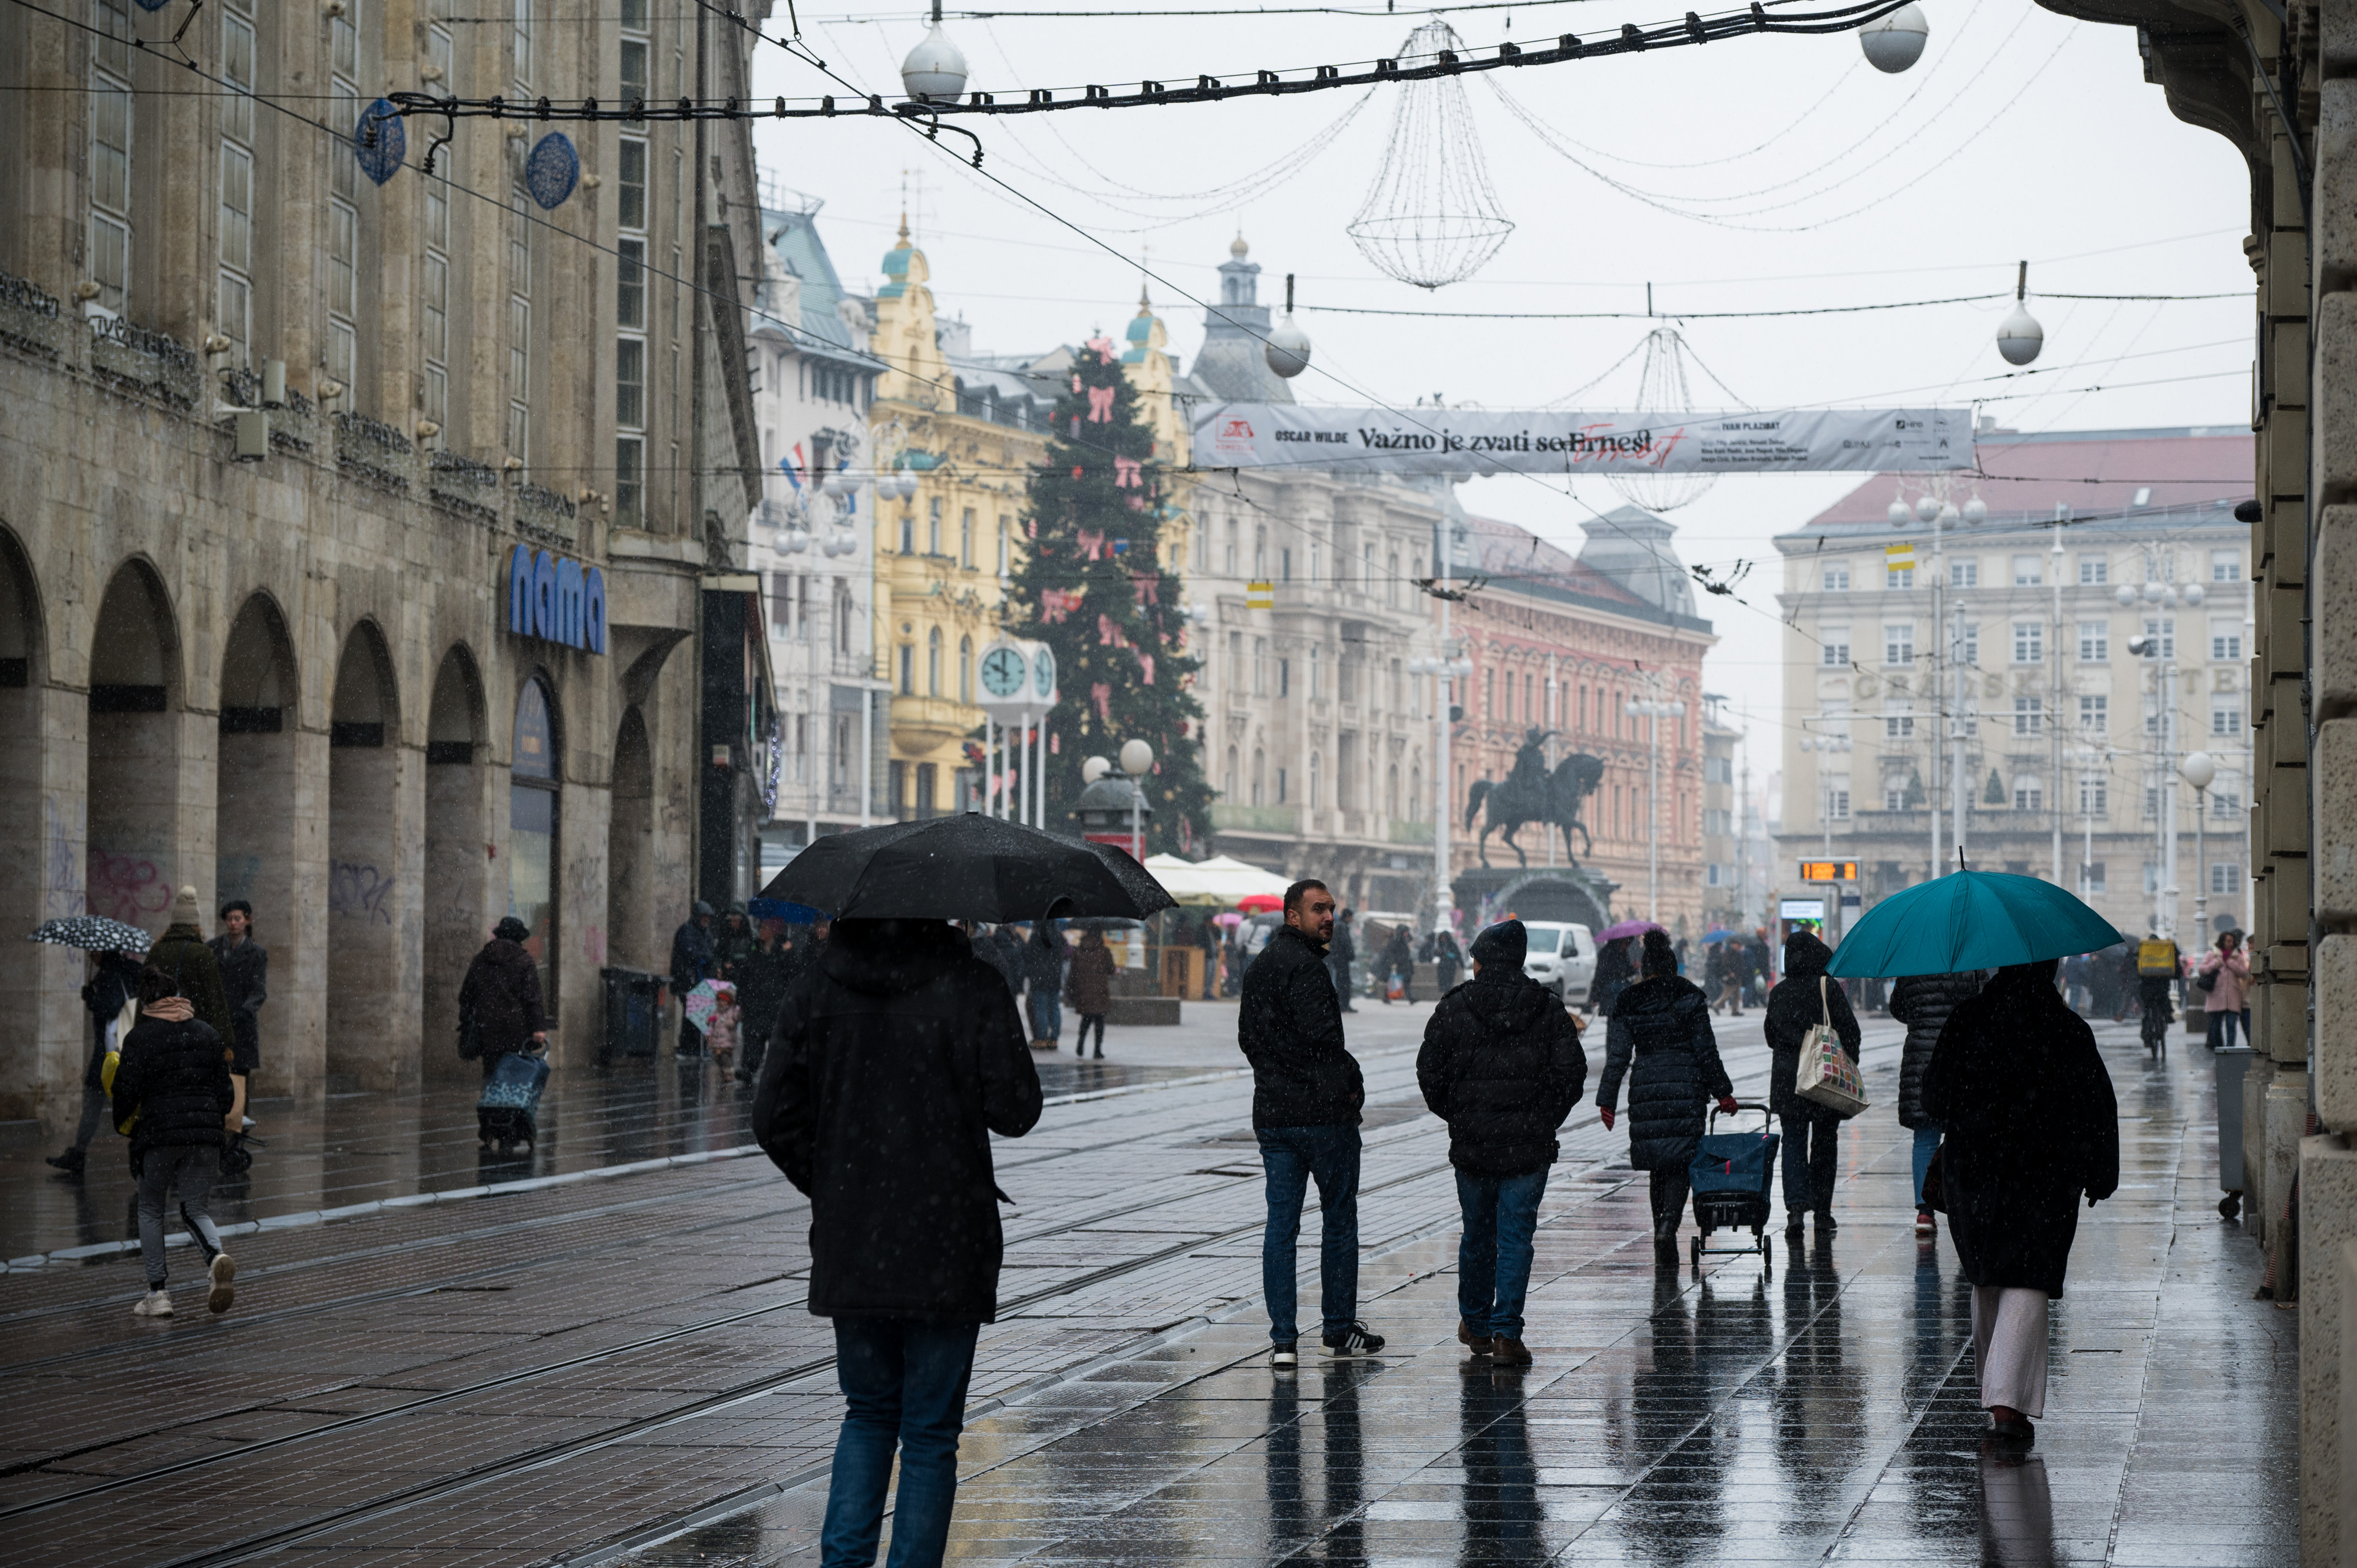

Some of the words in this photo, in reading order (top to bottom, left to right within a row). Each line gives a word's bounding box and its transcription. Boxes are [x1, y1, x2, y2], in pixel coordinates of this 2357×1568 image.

[1275, 430, 1311, 442] OSCAR
[1314, 431, 1349, 443] WILDE
[1358, 427, 1437, 450] Važno
[1441, 428, 1464, 454] je
[1470, 430, 1530, 451] zvati
[1536, 436, 1564, 452] se
[510, 543, 606, 655] nama
